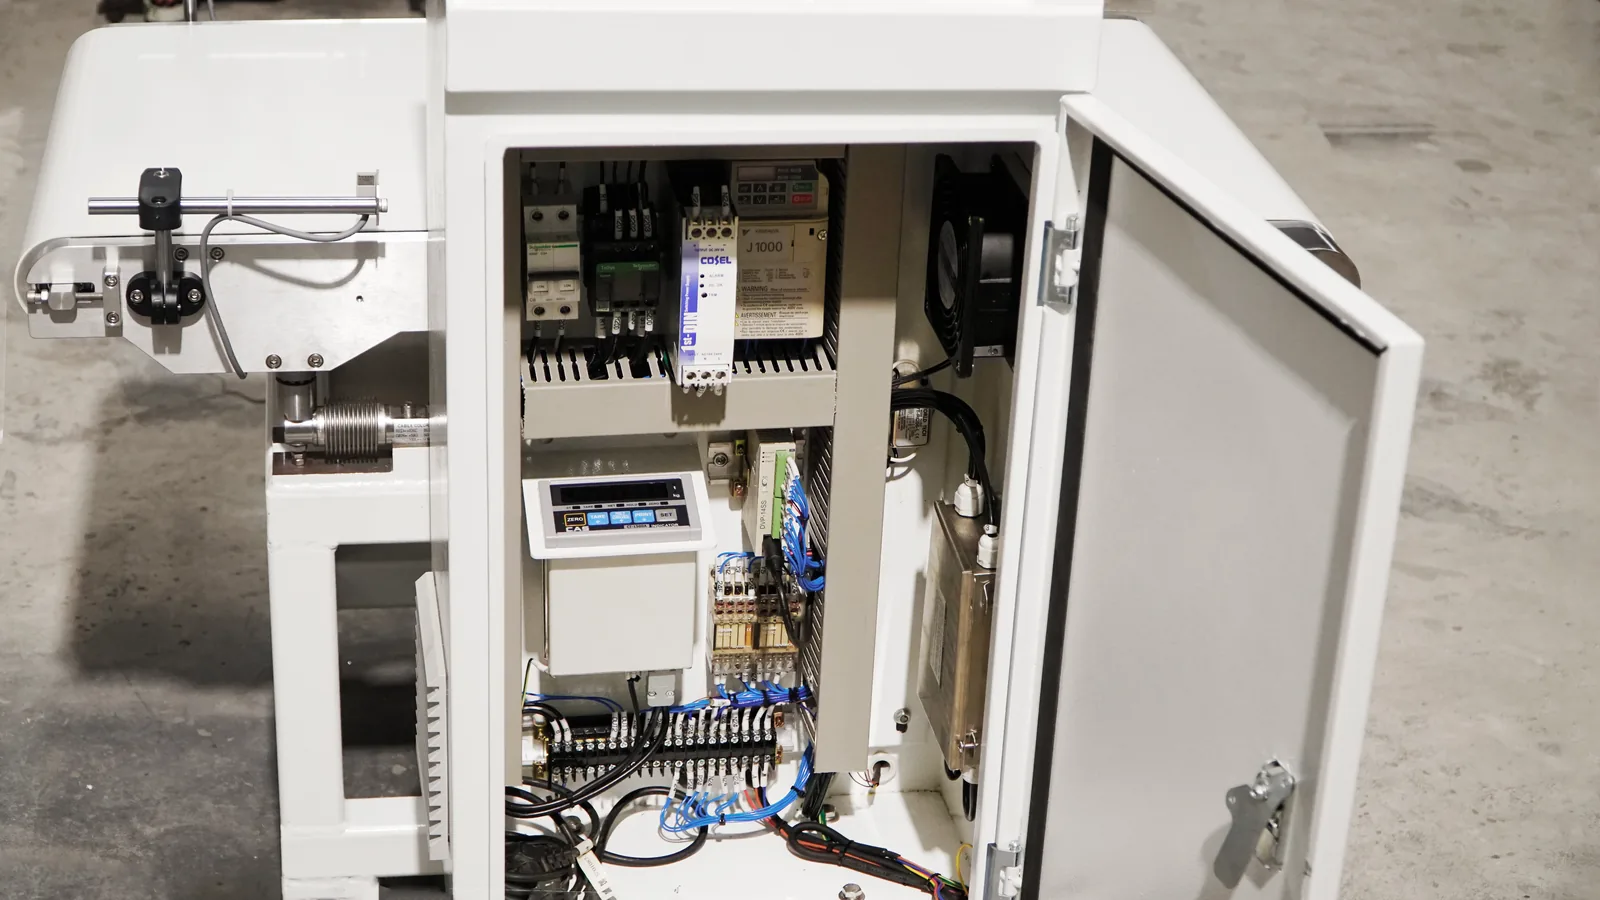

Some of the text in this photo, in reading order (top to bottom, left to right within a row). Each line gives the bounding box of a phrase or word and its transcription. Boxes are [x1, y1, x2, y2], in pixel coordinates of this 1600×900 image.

[746, 241, 783, 253] J1000
[700, 255, 732, 265] COSEL
[759, 500, 767, 530] DVP-14SS
